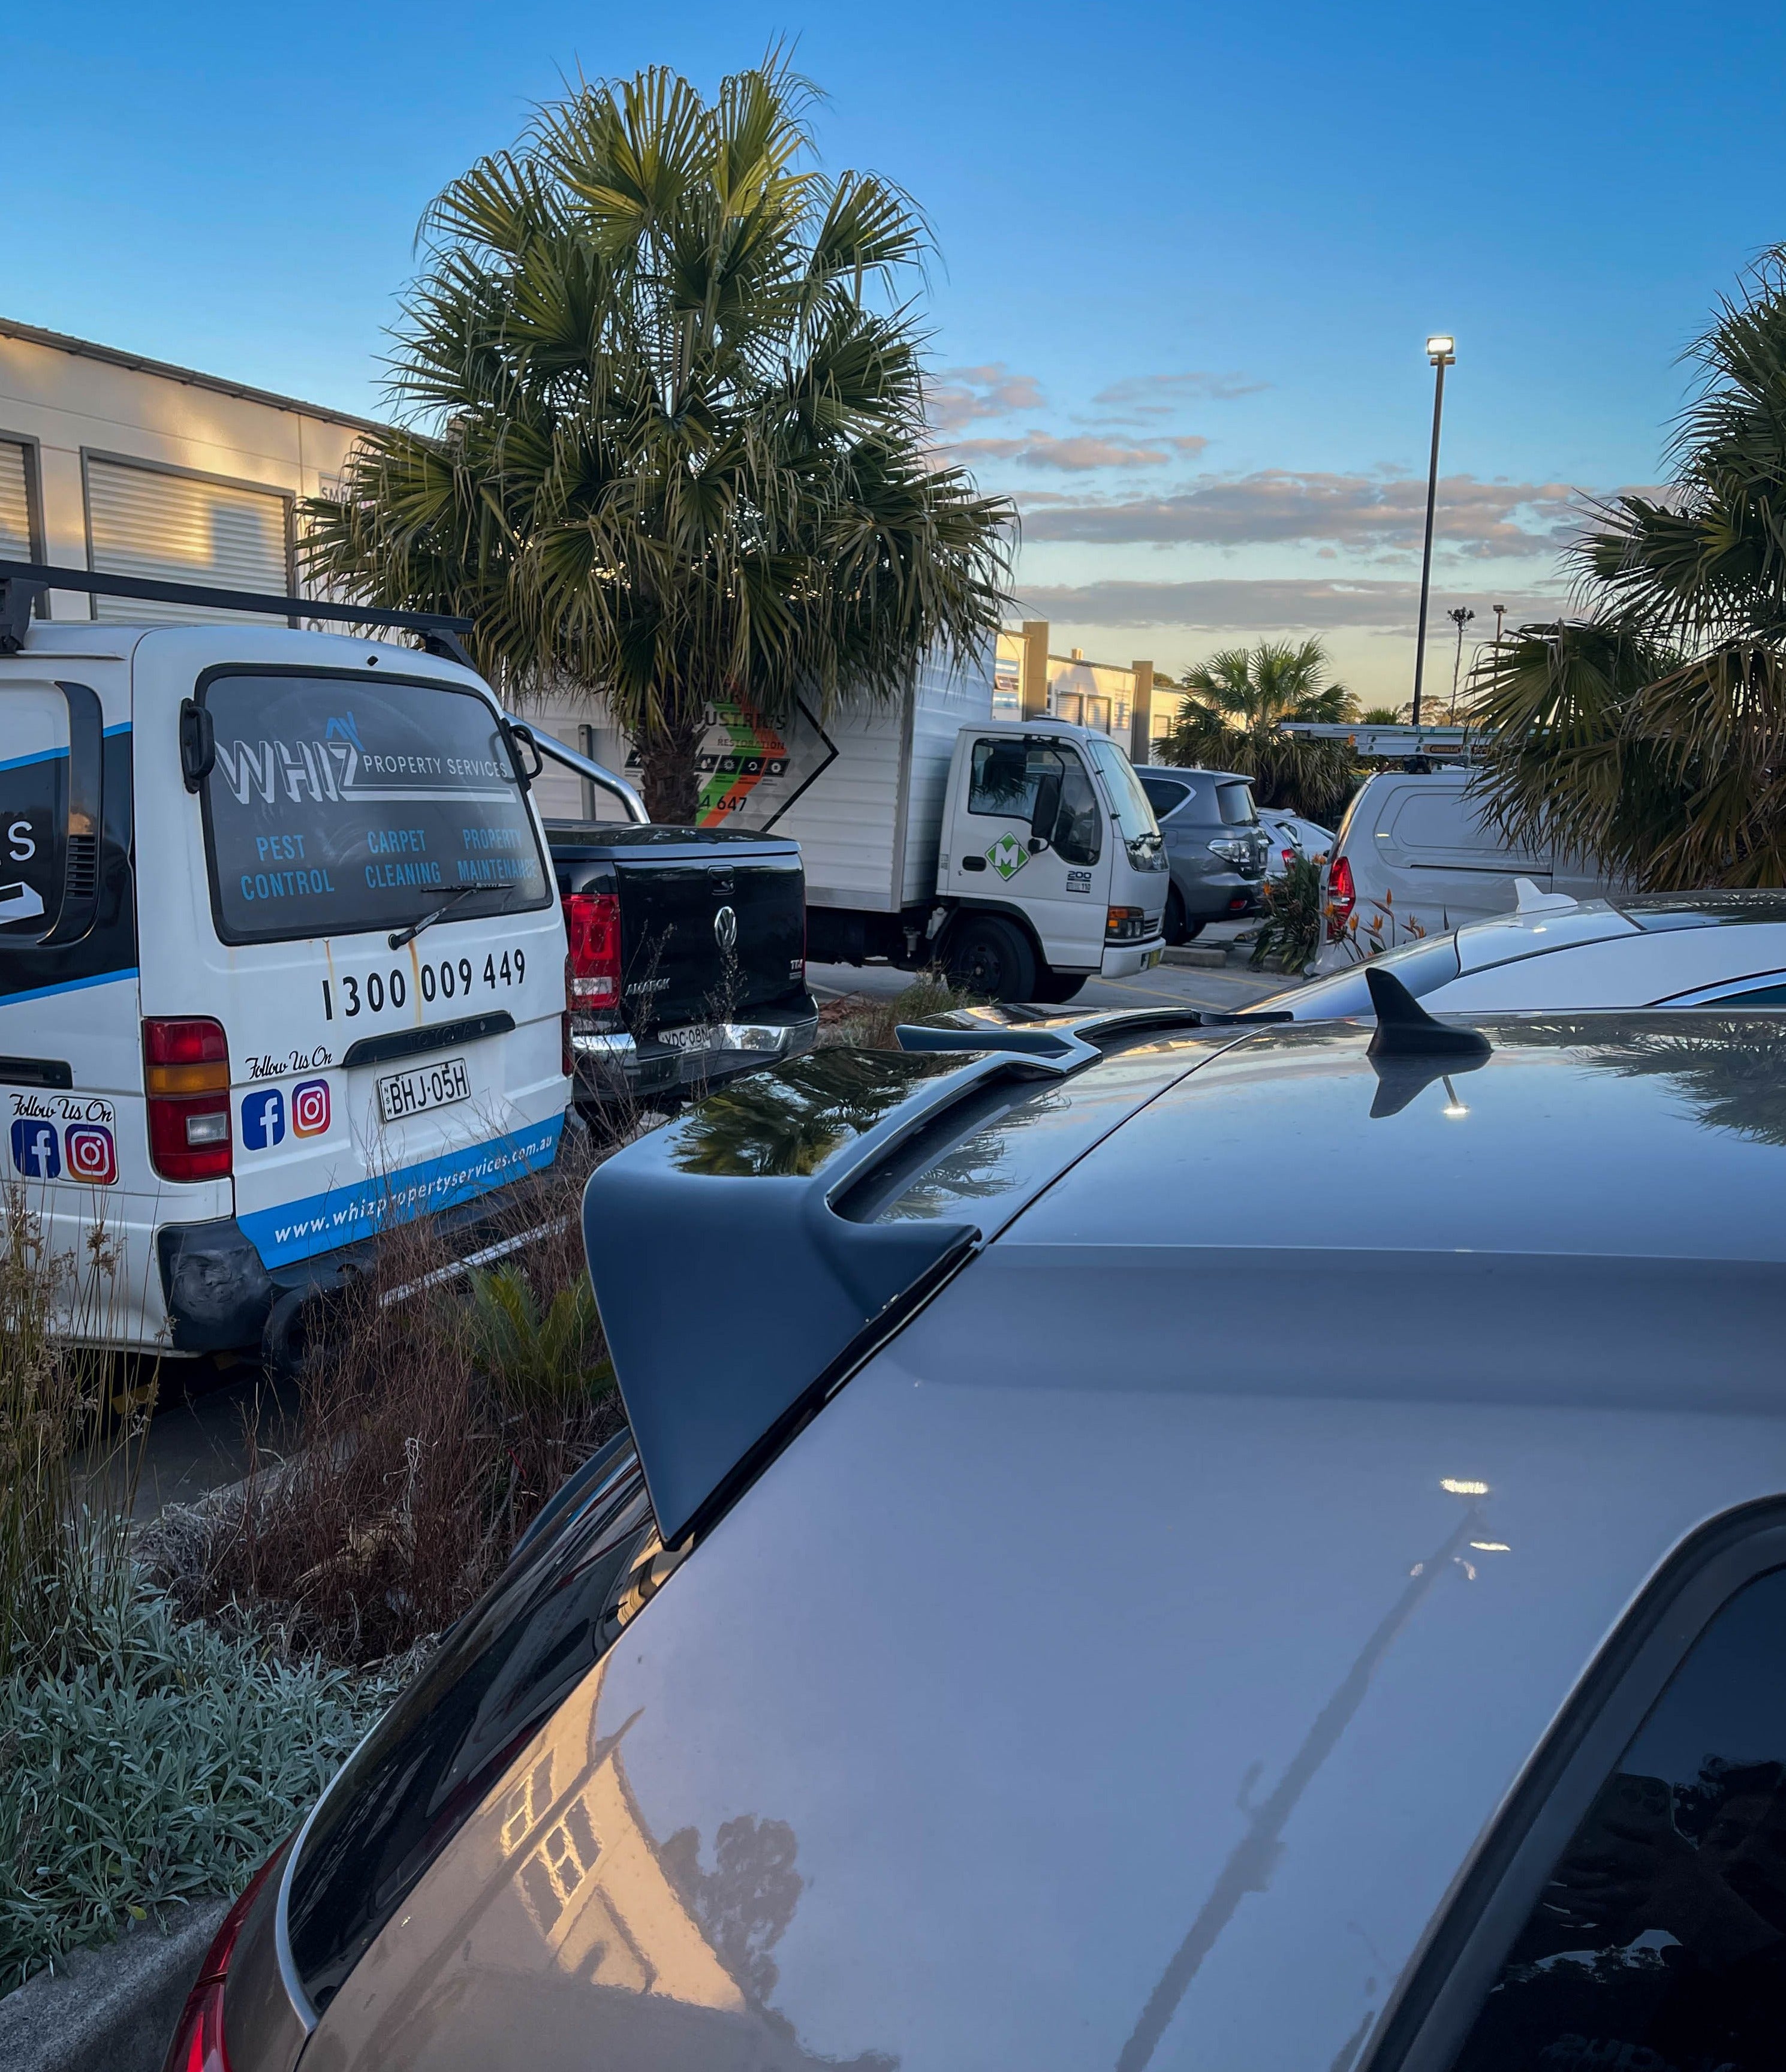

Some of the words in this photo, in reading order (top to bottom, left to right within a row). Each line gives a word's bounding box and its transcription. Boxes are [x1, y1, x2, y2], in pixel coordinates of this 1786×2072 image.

[717, 738, 785, 750] RESTORATION
[215, 740, 359, 805] WHIZ
[363, 755, 441, 775] PROPERTY
[447, 758, 507, 778] SERVICES
[716, 796, 747, 812] 647
[255, 834, 305, 862] PEST
[367, 829, 426, 854] CARPET
[462, 828, 522, 850] PROPERTY
[364, 862, 441, 889] CLEANING
[457, 857, 537, 882] MAINTENANCE
[1067, 871, 1092, 879] 200
[240, 869, 335, 901] CONTROL
[322, 969, 406, 1020] 1300
[421, 957, 472, 1002] 009
[483, 948, 525, 989] 449
[408, 1022, 471, 1048] TOYOTA
[245, 1055, 288, 1080] Follow
[289, 1050, 310, 1071] Us
[312, 1045, 333, 1067] On
[9, 1094, 56, 1118] Follow
[57, 1098, 83, 1120] Us
[86, 1099, 113, 1122] On
[275, 1134, 553, 1243] www.whizpropertyservices.com.au
